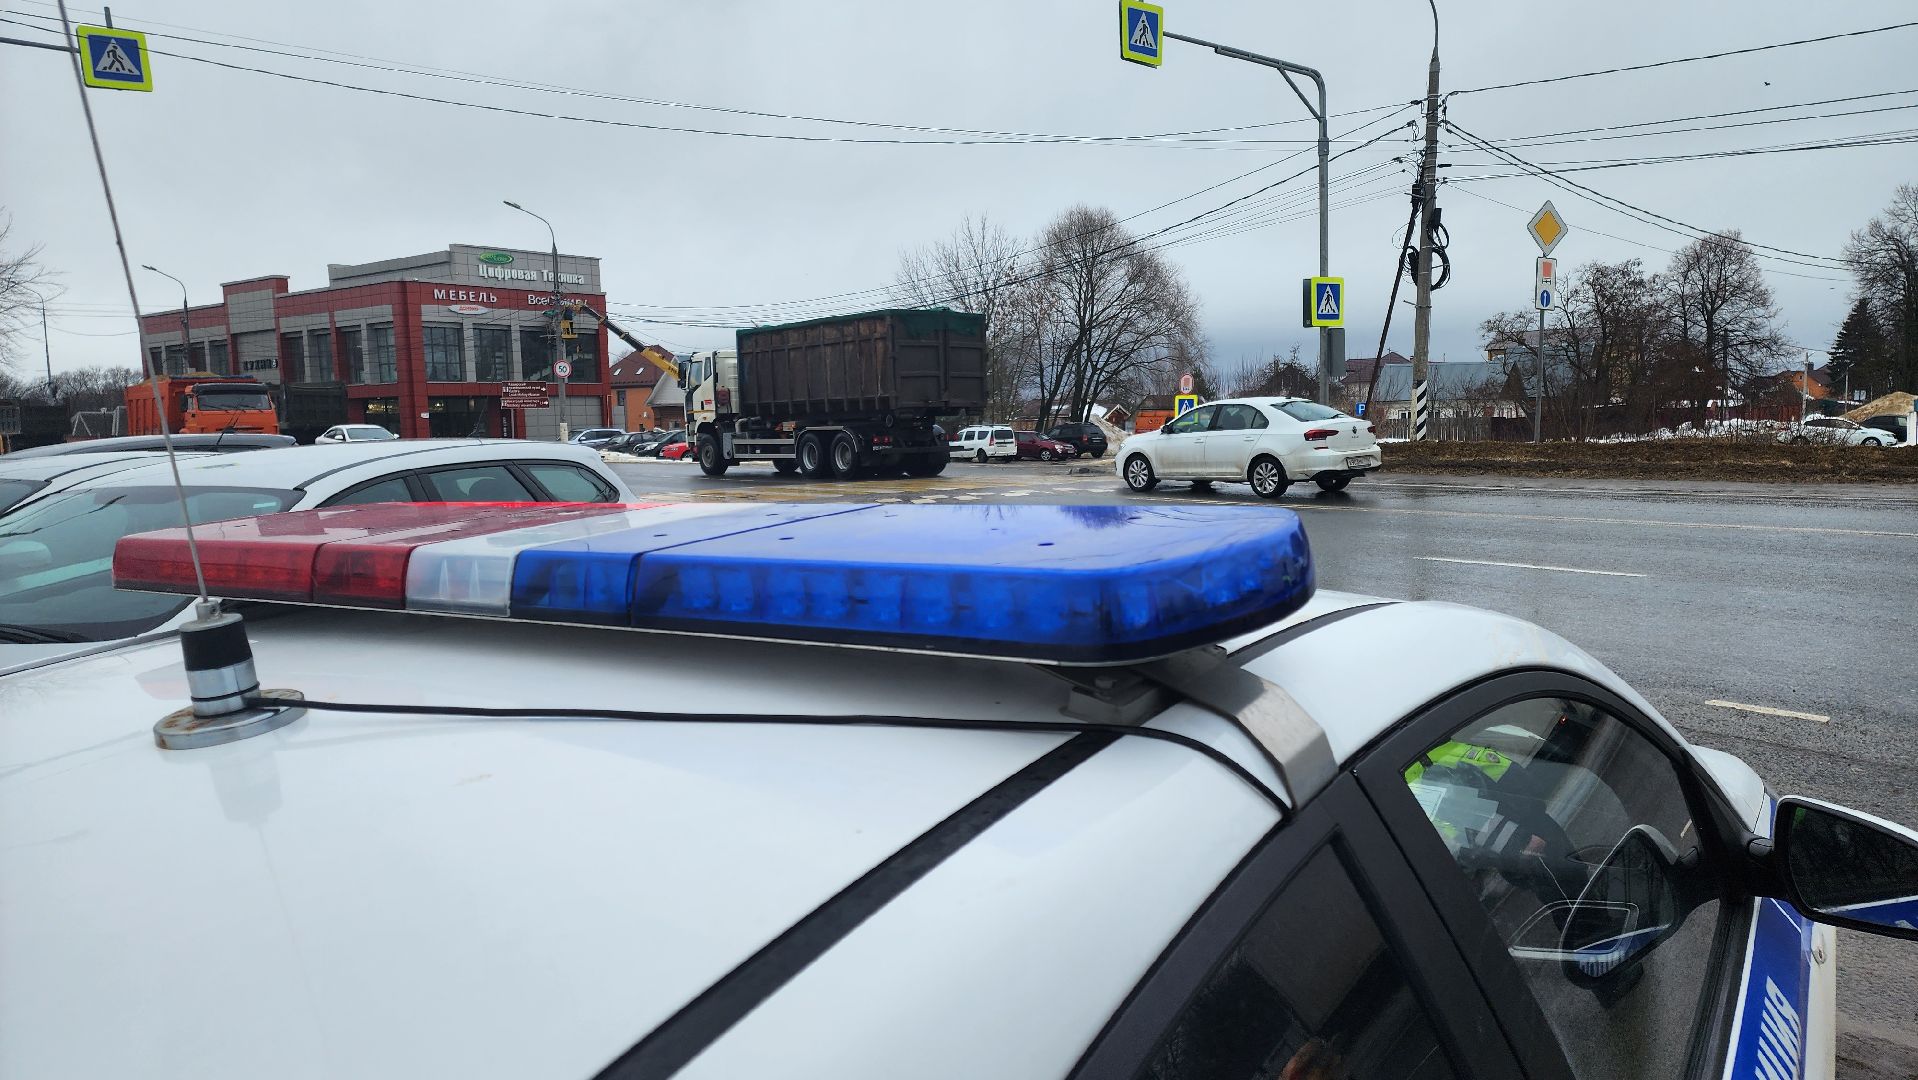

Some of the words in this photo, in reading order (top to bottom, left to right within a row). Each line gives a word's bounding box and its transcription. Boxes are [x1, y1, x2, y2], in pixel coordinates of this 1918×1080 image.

[478, 264, 537, 281] Цифровая
[541, 269, 585, 285] Техника
[434, 288, 498, 303] МЕБЕЛЬ
[558, 365, 568, 374] 50
